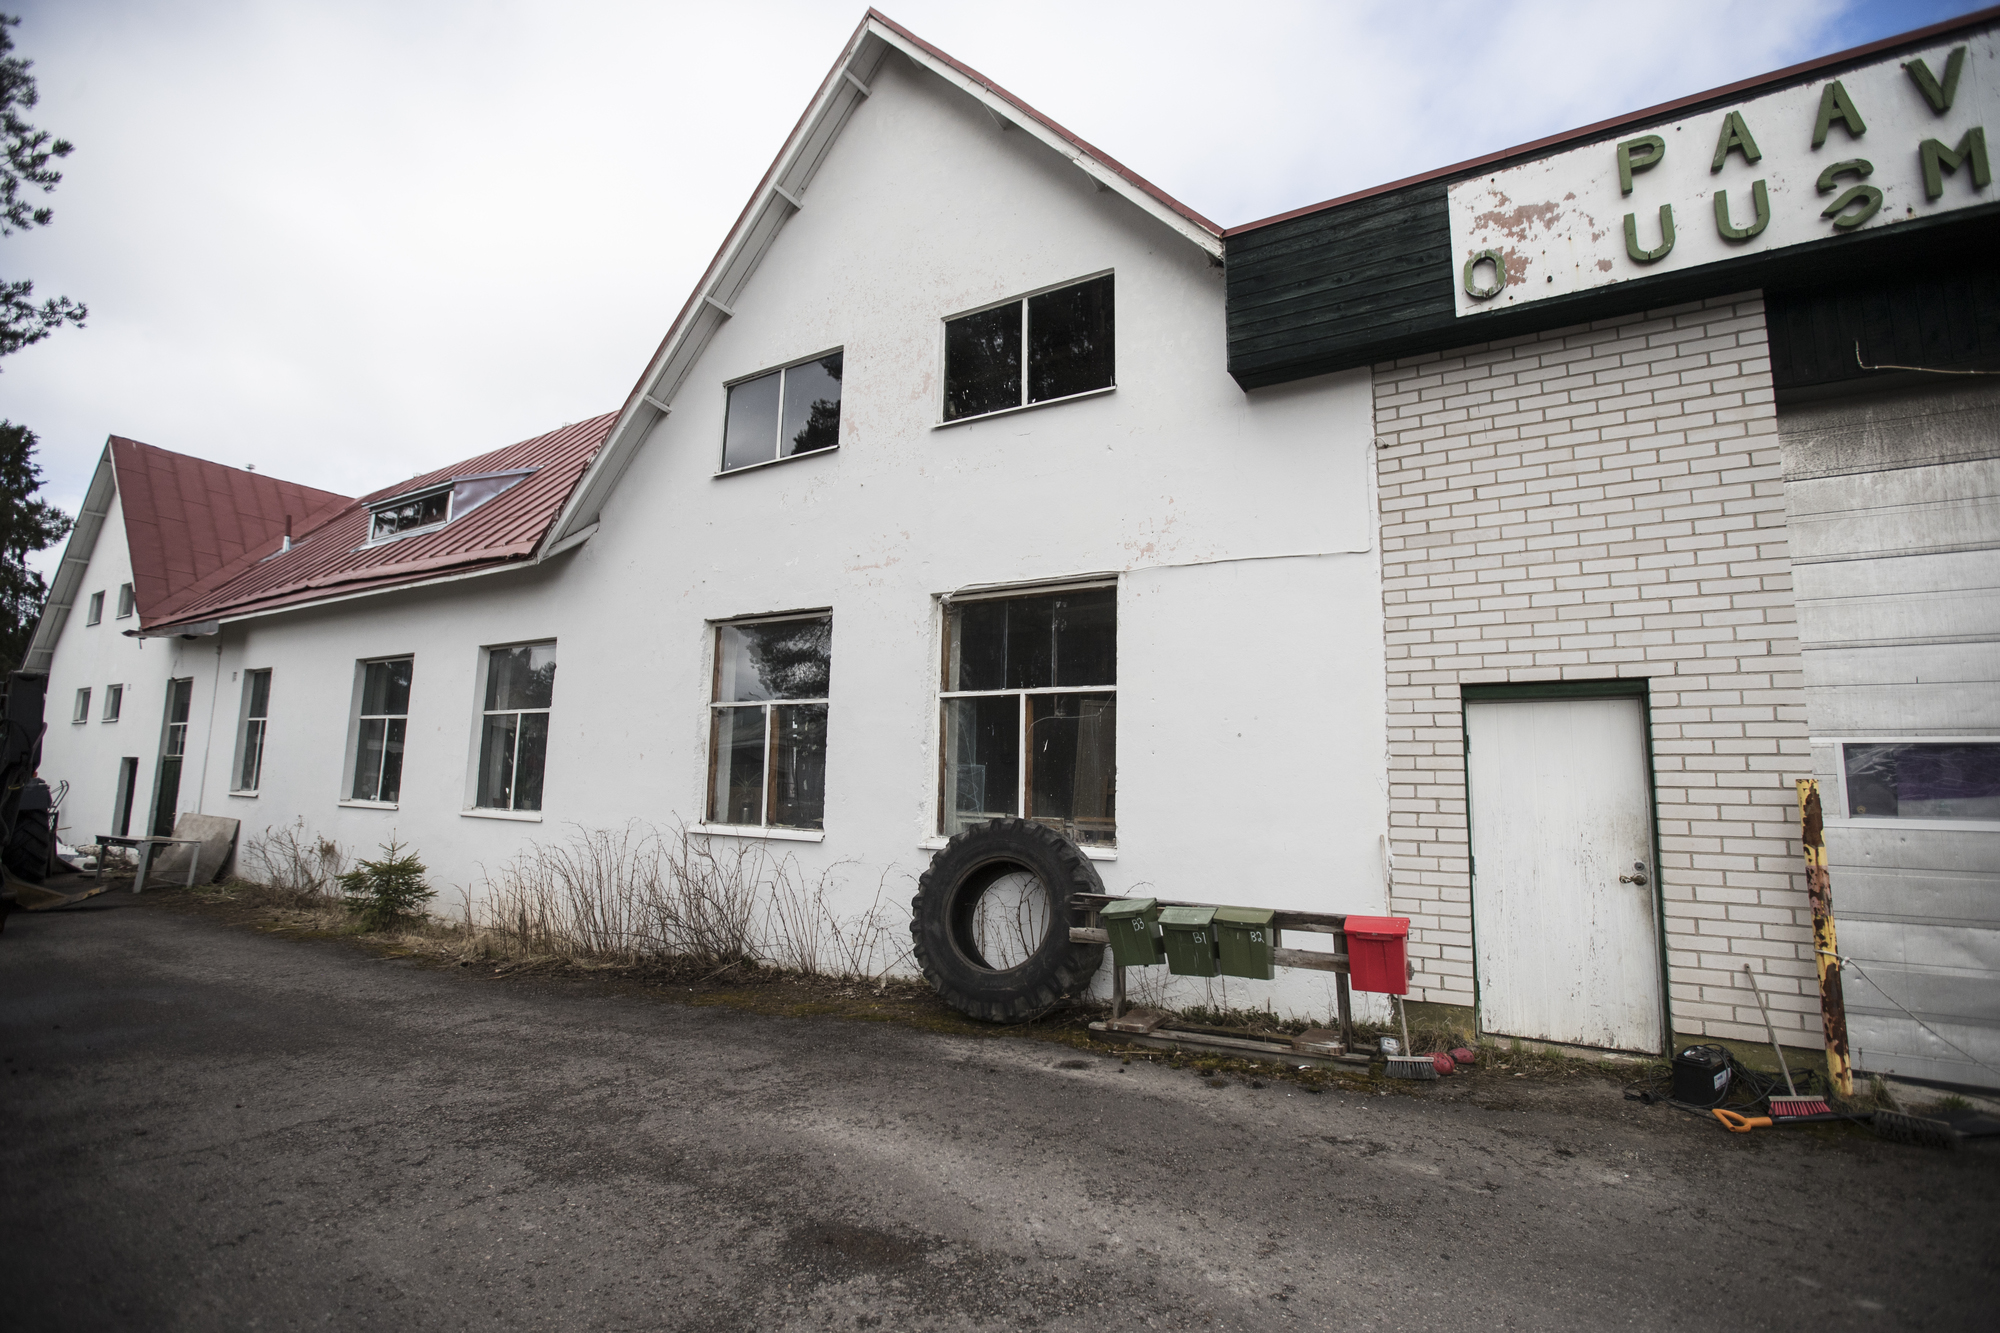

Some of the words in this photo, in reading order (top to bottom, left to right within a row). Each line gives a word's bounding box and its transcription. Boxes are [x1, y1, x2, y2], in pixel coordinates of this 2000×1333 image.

[1131, 917, 1146, 932] B3
[1192, 931, 1207, 945] B1
[1249, 931, 1265, 944] B2
